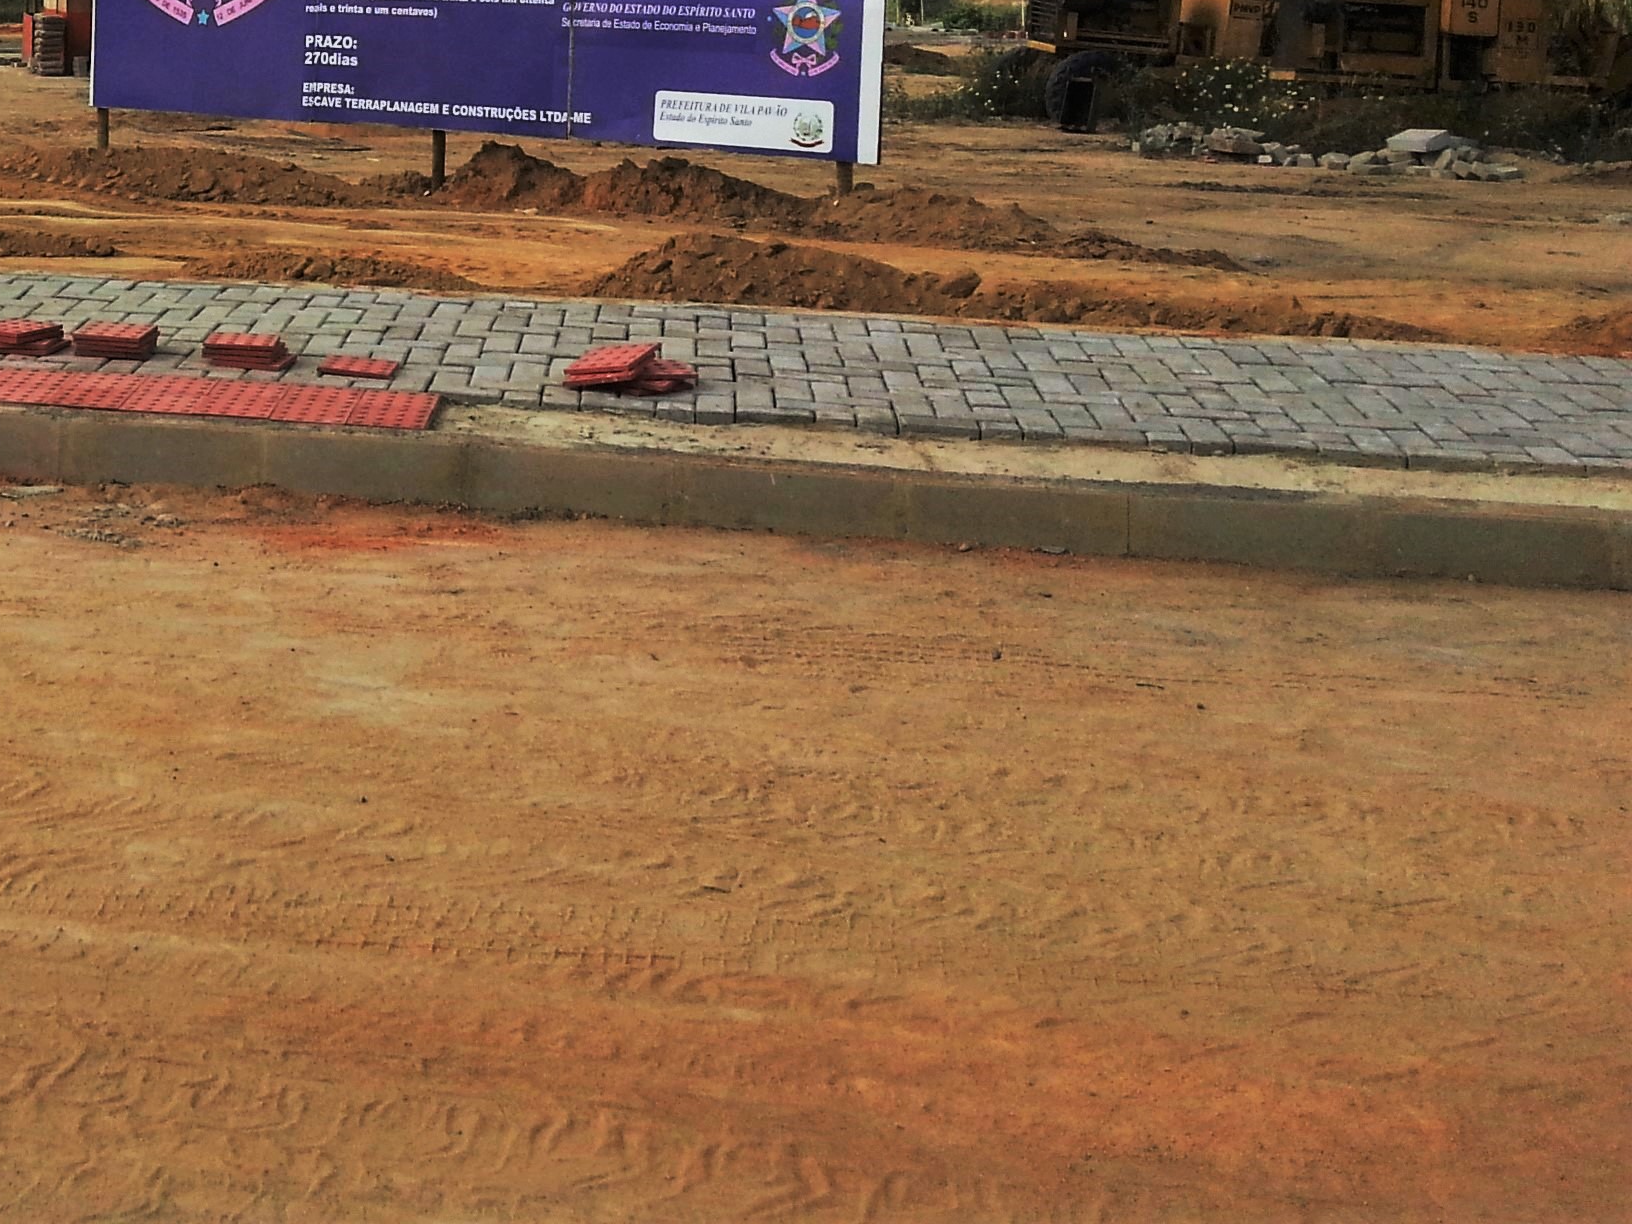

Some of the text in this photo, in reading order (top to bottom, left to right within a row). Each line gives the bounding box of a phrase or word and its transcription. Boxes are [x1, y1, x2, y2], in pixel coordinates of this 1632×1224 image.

[337, 4, 364, 15] trinta
[365, 7, 372, 15] e
[374, 7, 389, 15] um
[609, 3, 624, 14] DO
[624, 3, 660, 15] ESTADO
[662, 4, 677, 16] DO
[677, 3, 722, 18] ESPÍRITO
[722, 7, 756, 19] SANTO
[1468, 11, 1478, 23] S
[602, 18, 613, 28] de
[613, 18, 641, 30] Estado
[642, 20, 653, 30] de
[654, 20, 693, 32] Economia
[695, 24, 701, 32] e
[702, 22, 757, 36] Planejamento
[305, 35, 358, 49] PRAZO:
[304, 52, 358, 66] 270dias
[303, 82, 355, 94] EMPRESA:
[302, 96, 342, 108] ESCAVE
[344, 98, 439, 114] TERRAPLANAGEM
[442, 104, 449, 114] E
[452, 104, 537, 122] CONSTRUÇÕES
[660, 99, 717, 112] PREFEITURA
[719, 103, 731, 113] DE
[659, 111, 686, 122] Estado
